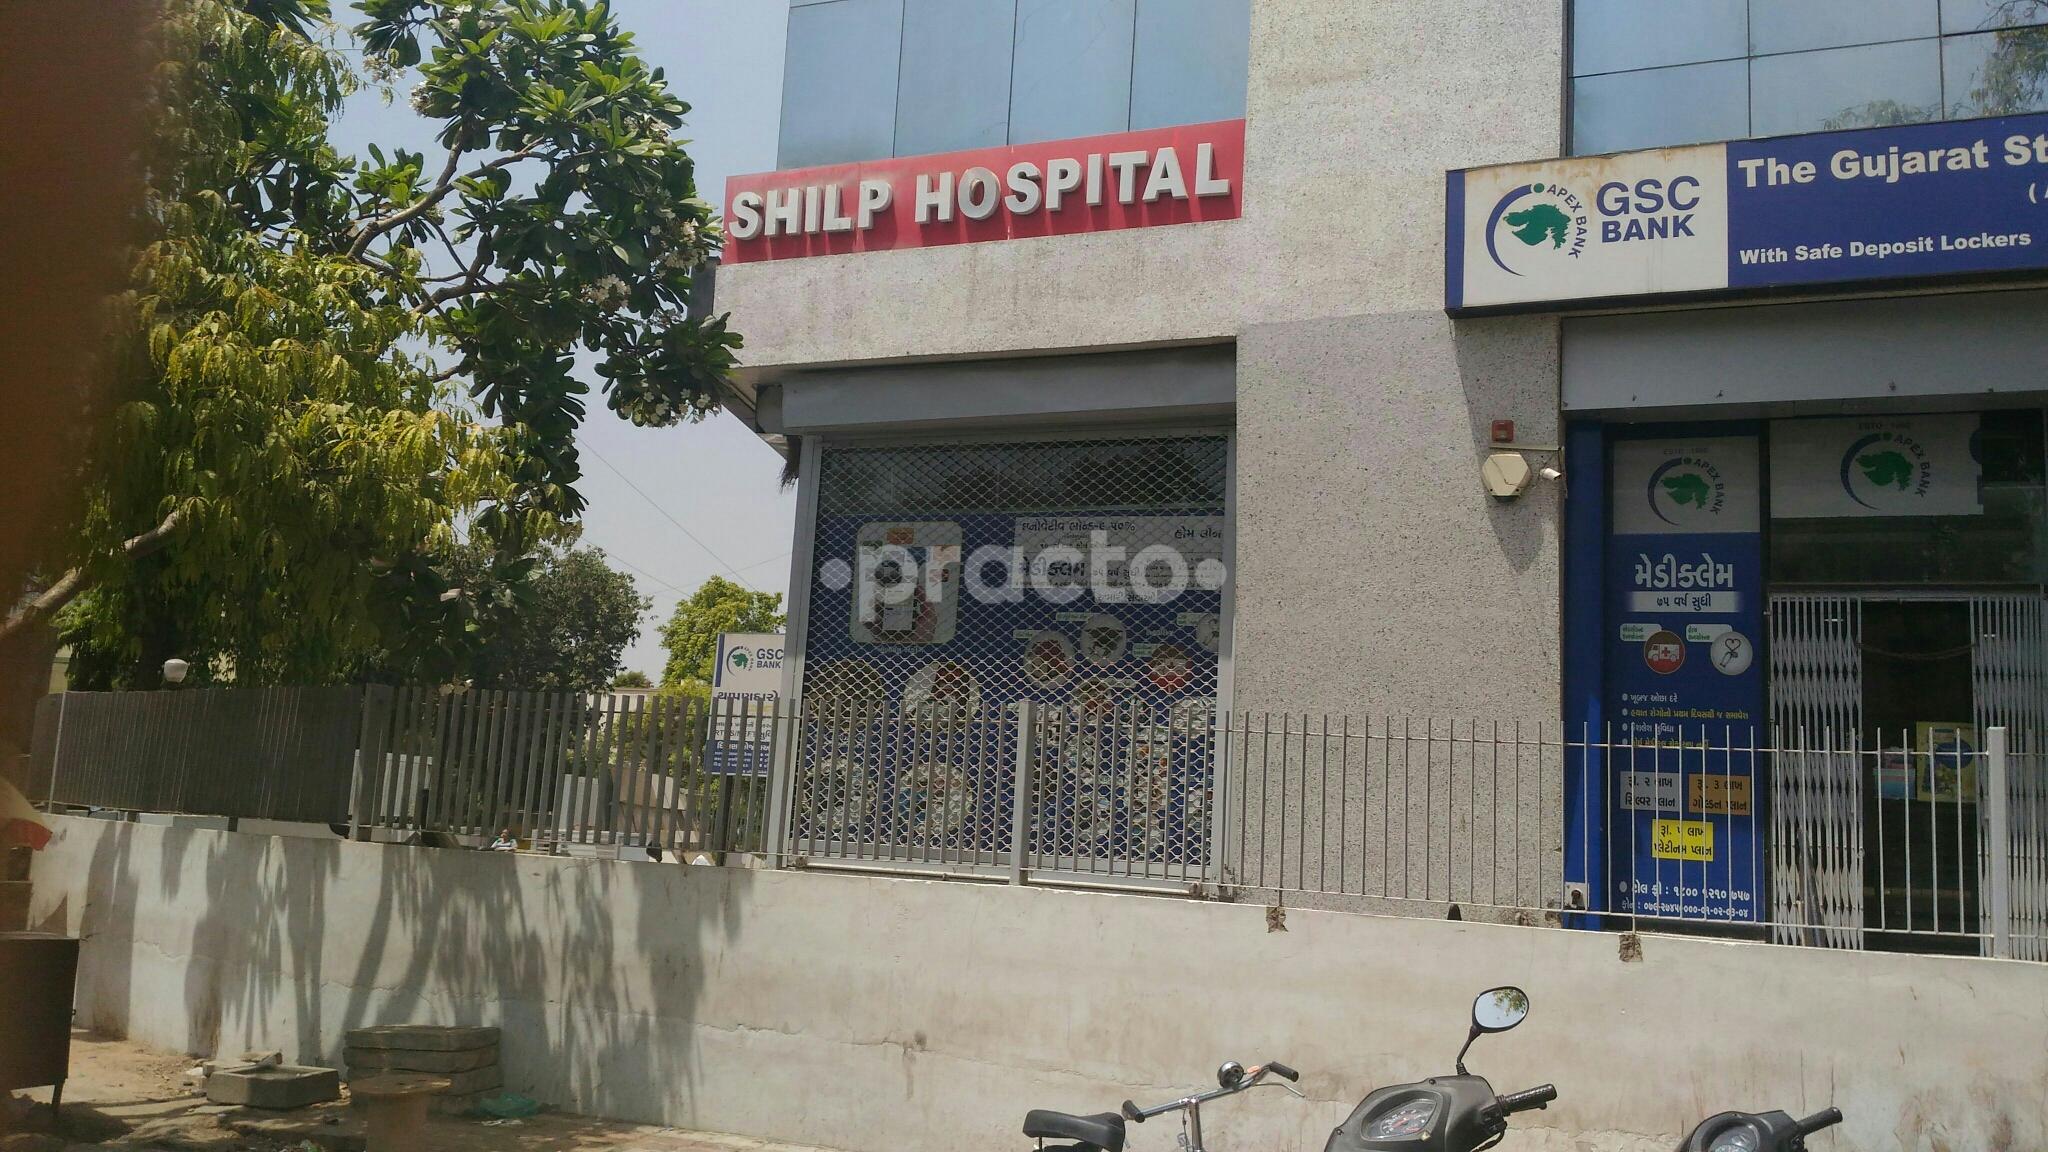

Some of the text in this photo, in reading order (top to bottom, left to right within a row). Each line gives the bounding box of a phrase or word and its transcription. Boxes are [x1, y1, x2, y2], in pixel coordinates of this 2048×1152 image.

[1738, 157, 1816, 187] The
[1830, 139, 1990, 183] Gujarat
[728, 142, 1232, 240] SHILP HOSPITAL
[1595, 175, 1701, 217] GSC
[1547, 183, 1588, 260] APEX BANK
[1601, 213, 1696, 244] BANK
[1740, 229, 2032, 266] With Safe Deposit Lockers
[1894, 433, 1926, 460] APEX
[1914, 461, 1931, 498] BANK
[1694, 458, 1721, 482] APEX
[1709, 482, 1725, 516] BANK
[1656, 592, 1712, 611] ૭૫ વર્ષ સુધી
[756, 647, 784, 660] GSC
[756, 660, 781, 669] BANK
